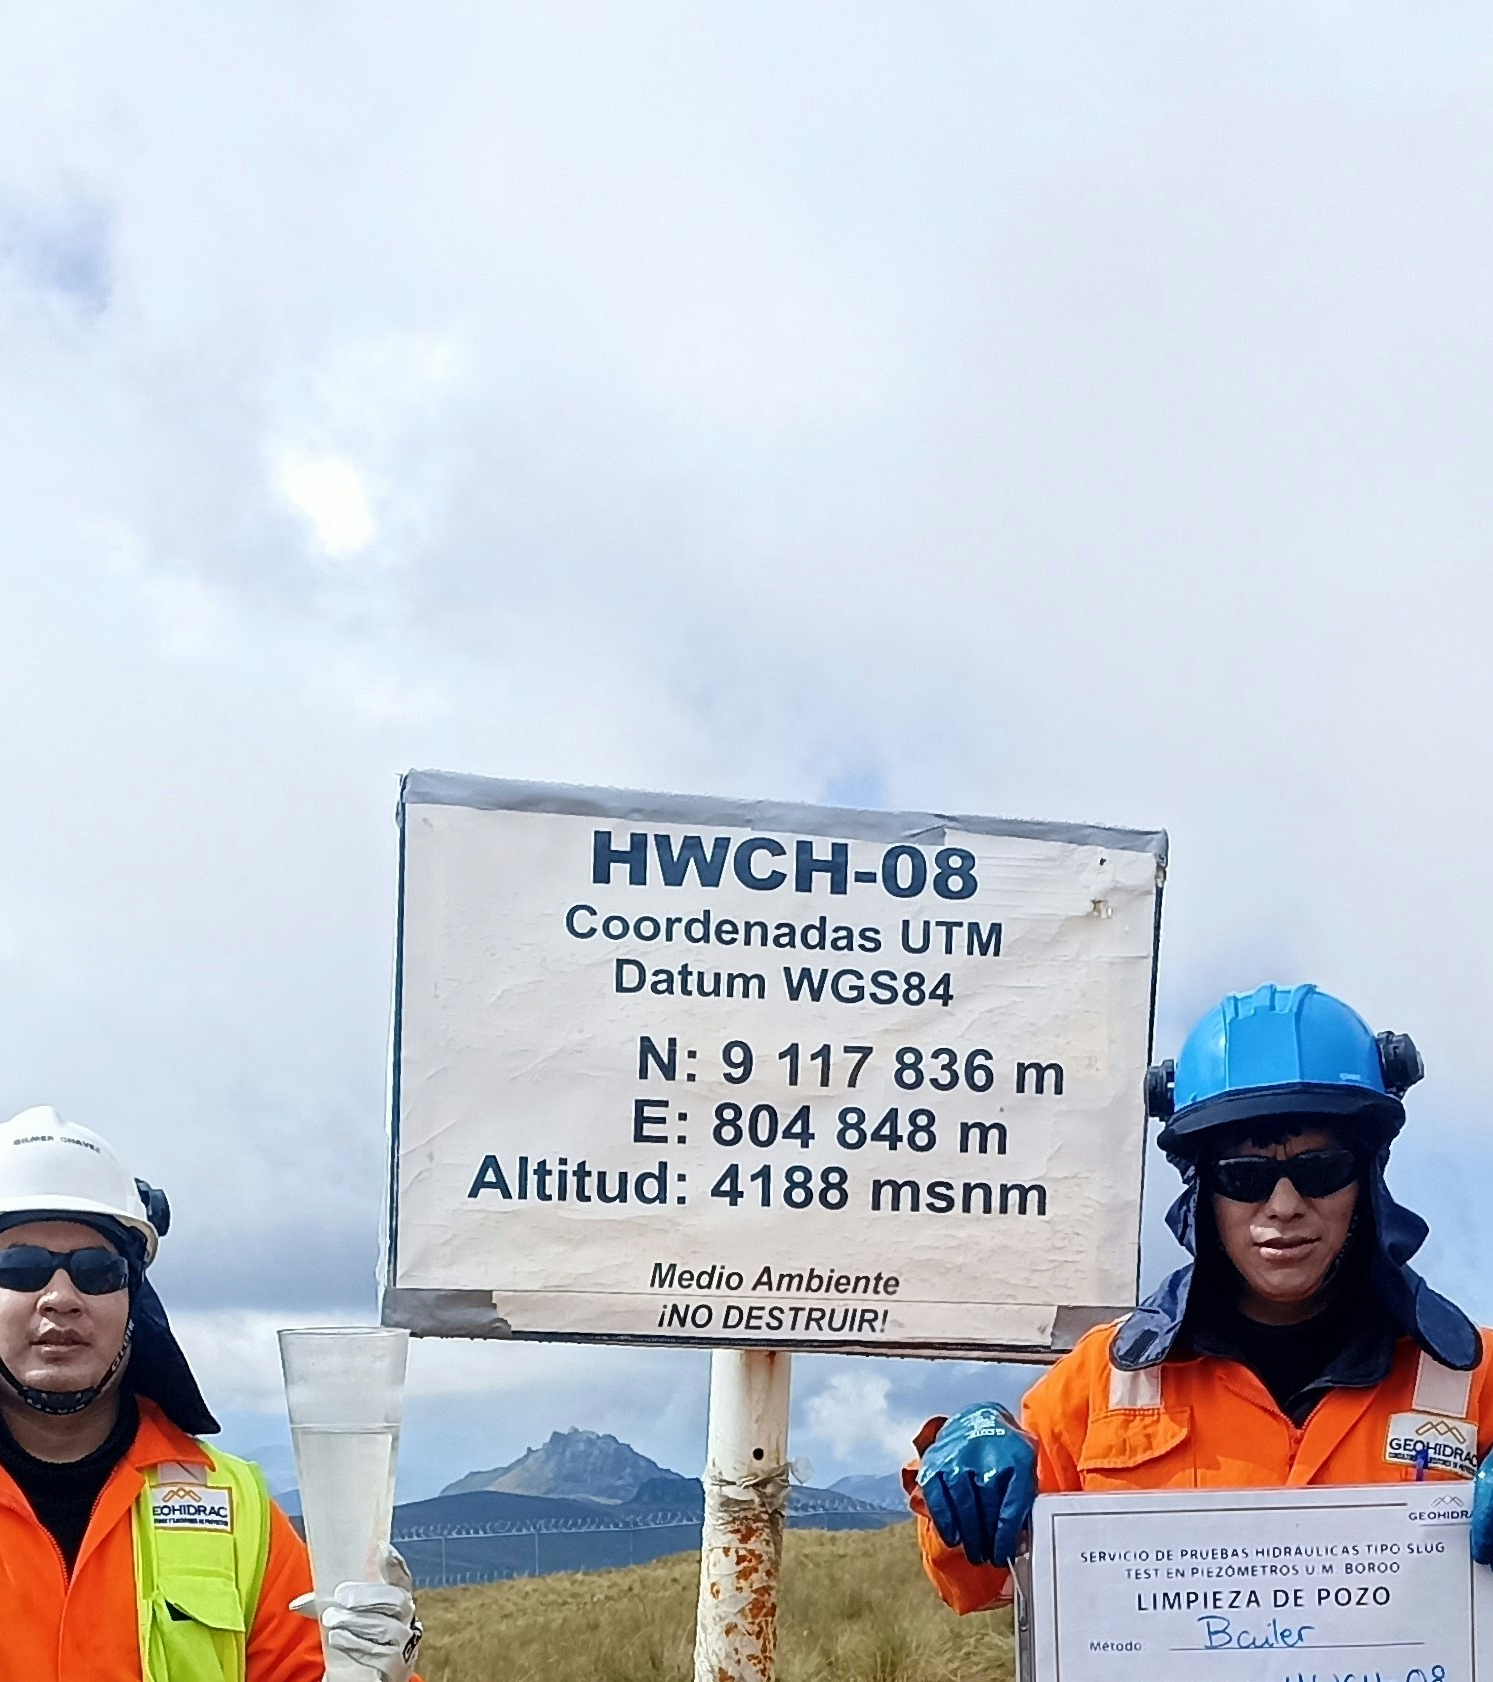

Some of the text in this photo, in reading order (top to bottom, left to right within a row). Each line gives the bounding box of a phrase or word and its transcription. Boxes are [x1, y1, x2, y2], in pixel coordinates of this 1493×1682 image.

[591, 829, 979, 901] HWCH-08
[565, 903, 1003, 957] Coordenadas UTM
[614, 957, 954, 1008] Datum WGS84
[637, 1036, 1065, 1096] N: 9 117 836 m
[632, 1099, 1009, 1155] E: 804 848 m
[467, 1154, 1048, 1216] Altitud: 4188 msnm
[649, 1262, 901, 1296] Medio Ambiente
[657, 1303, 890, 1334] ¡NO DESTRUIR!
[1388, 1437, 1478, 1468] GEOHIDRAC
[152, 1504, 228, 1519] EOHIDRAC
[1080, 1550, 1150, 1563] SERVICIO
[1155, 1549, 1174, 1562] DE
[1180, 1548, 1250, 1561] PRUEBAS
[1365, 1543, 1401, 1556] TIPO
[1406, 1541, 1446, 1554] SLUG
[1124, 1567, 1161, 1580] TEST
[1166, 1567, 1186, 1579] EN
[1344, 1561, 1401, 1575] BOROO
[1137, 1585, 1392, 1612] LIMPIEZA DE POZO
